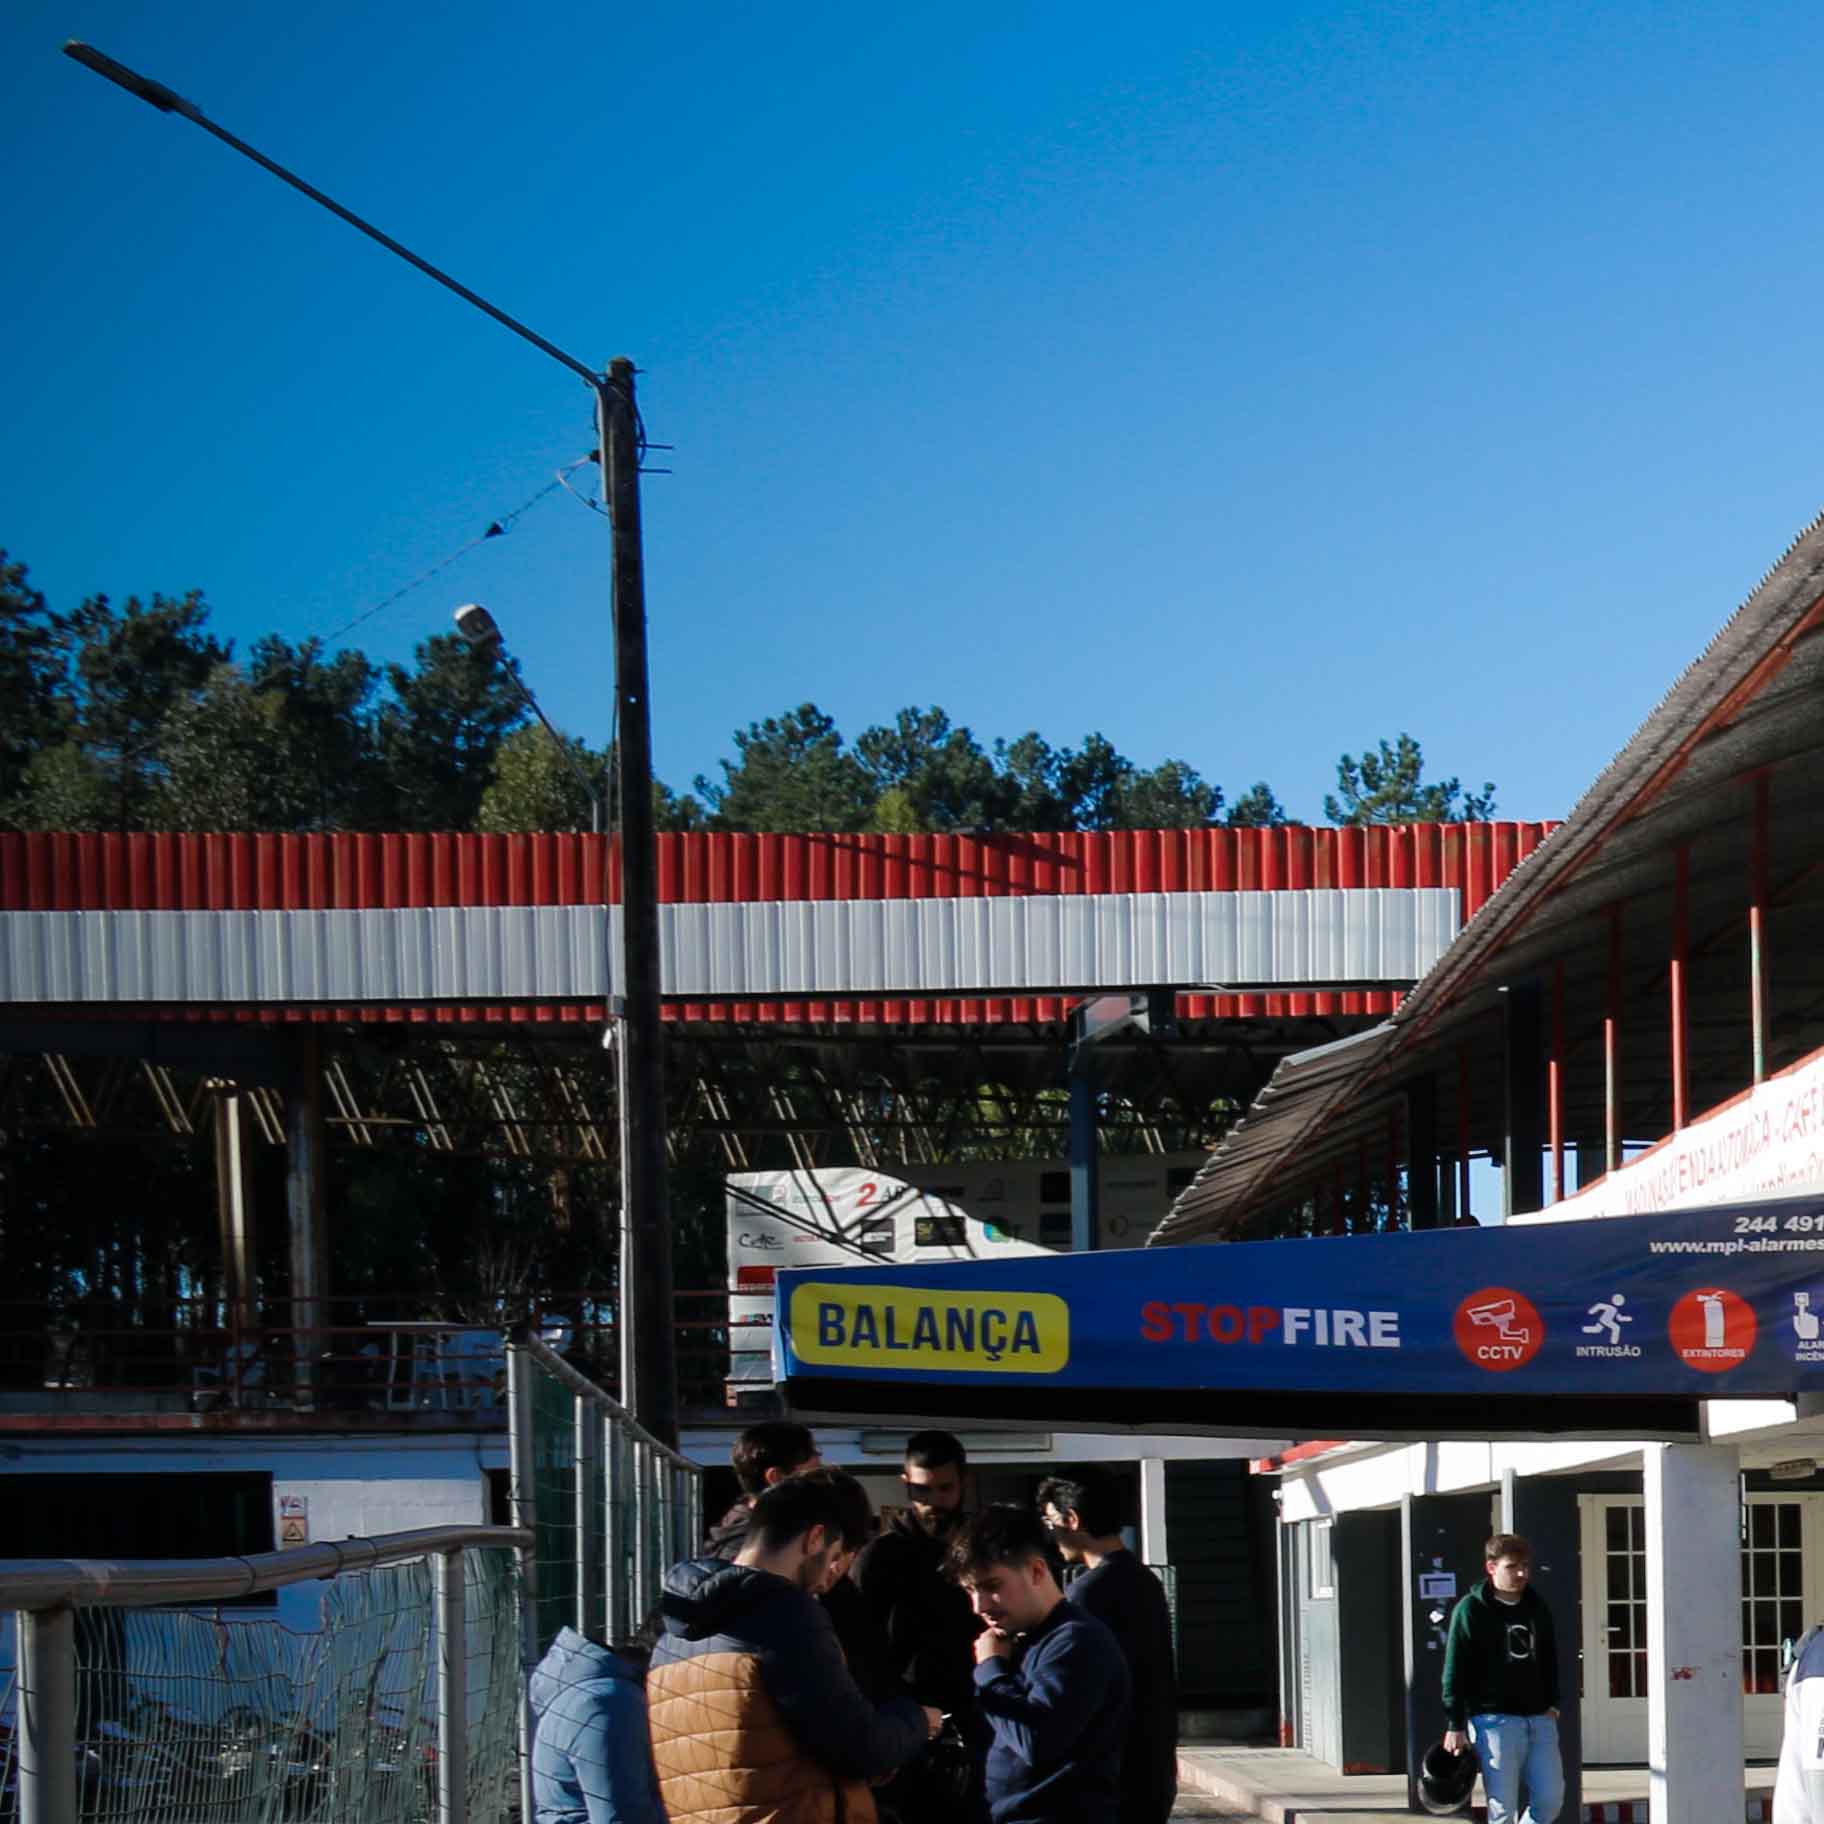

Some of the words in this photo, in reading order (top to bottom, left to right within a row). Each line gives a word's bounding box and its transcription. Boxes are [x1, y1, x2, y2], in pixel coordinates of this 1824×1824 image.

[1733, 1216, 1778, 1233] 244
[818, 1302, 1042, 1362] BALANÇA
[1140, 1301, 1401, 1349] STOPFIRE
[1477, 1346, 1524, 1360] CCTV
[1575, 1343, 1642, 1359] INTRUSÃO
[1682, 1348, 1746, 1360] EXTINTORES
